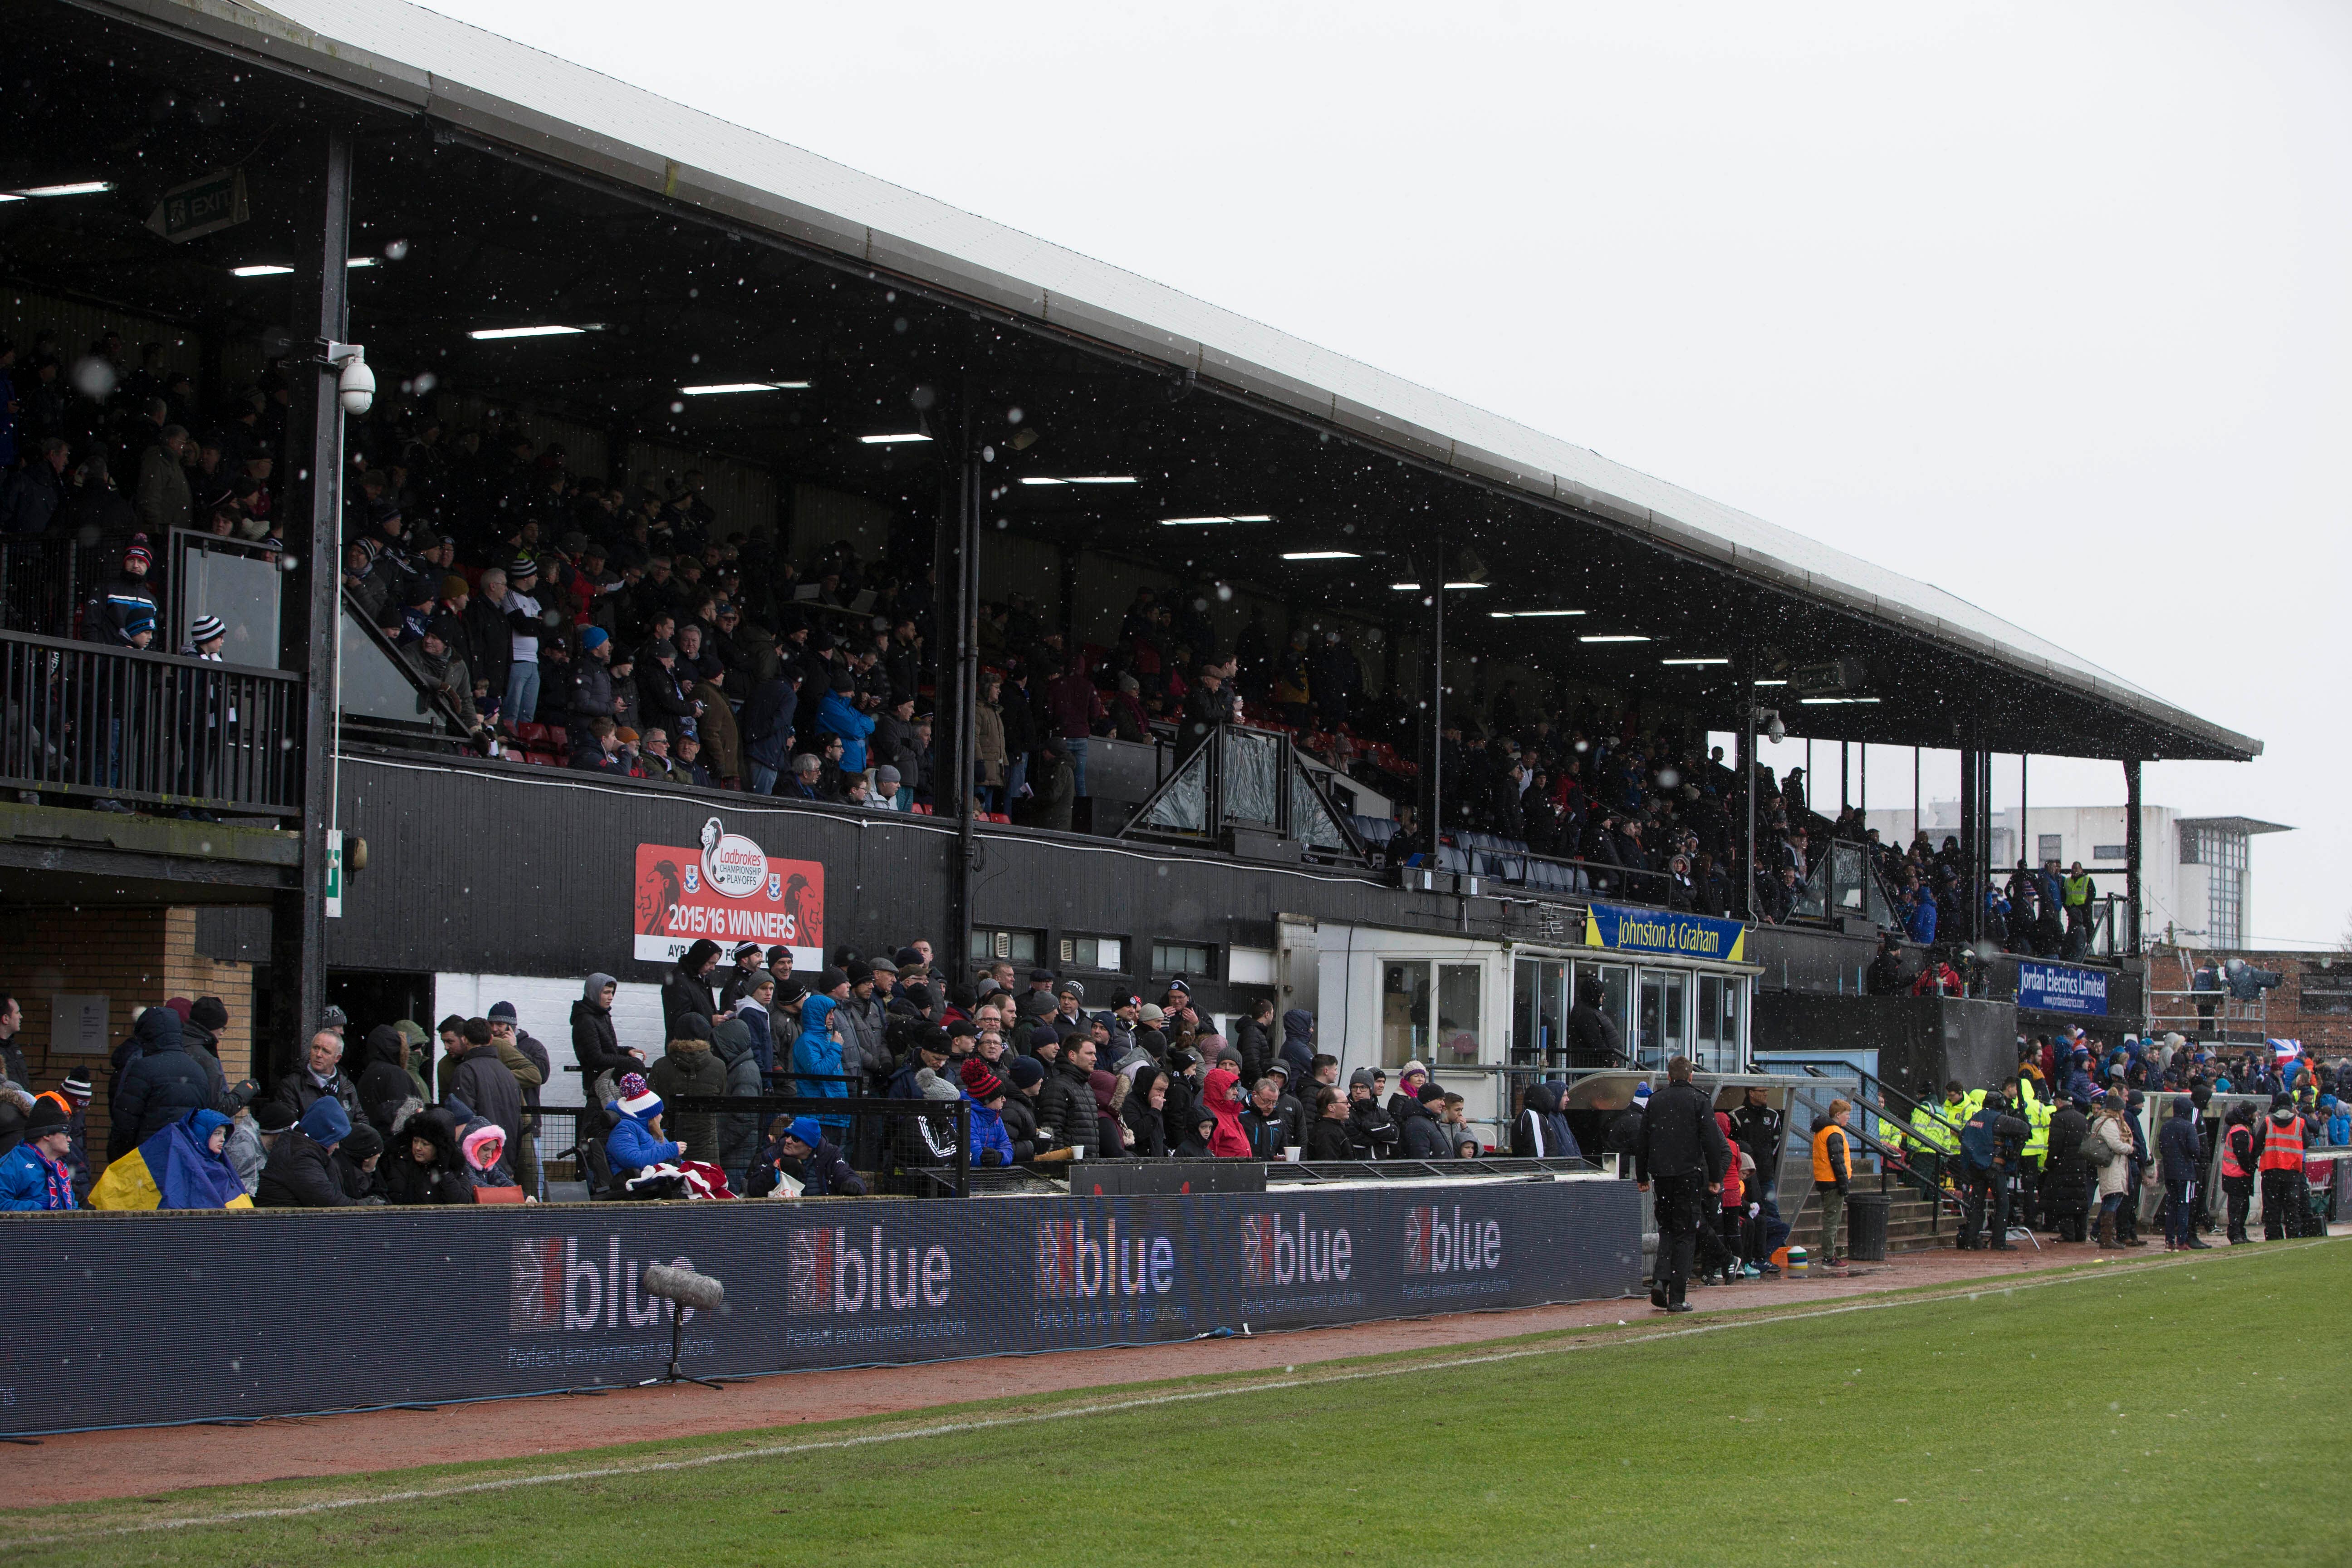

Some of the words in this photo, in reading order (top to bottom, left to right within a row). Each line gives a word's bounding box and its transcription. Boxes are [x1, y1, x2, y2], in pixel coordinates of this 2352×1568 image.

[191, 188, 233, 216] EXIT
[720, 848, 761, 867] Ladbrokes
[720, 864, 761, 875] CHAMPIONSHIP
[727, 874, 756, 885] PLAY-OFFS
[669, 904, 725, 934] 2015/16
[728, 909, 795, 939] WINNERS
[1617, 915, 1666, 948] Johnston
[1668, 923, 1676, 948] &
[1679, 922, 1719, 953] Graham
[2020, 965, 2045, 995] Jordan
[2047, 968, 2078, 995] Electrics
[2079, 971, 2106, 998] Limited
[1274, 1211, 1352, 1285] blue
[1431, 1205, 1501, 1273] blue
[835, 1225, 951, 1312] blue
[1076, 1218, 1174, 1297] blue
[786, 1325, 833, 1348] Perfect
[835, 1322, 913, 1344] environment
[916, 1317, 966, 1338] solutions
[508, 1344, 562, 1369] Perfect
[564, 1339, 654, 1365] environment
[658, 1335, 715, 1358] soutions
